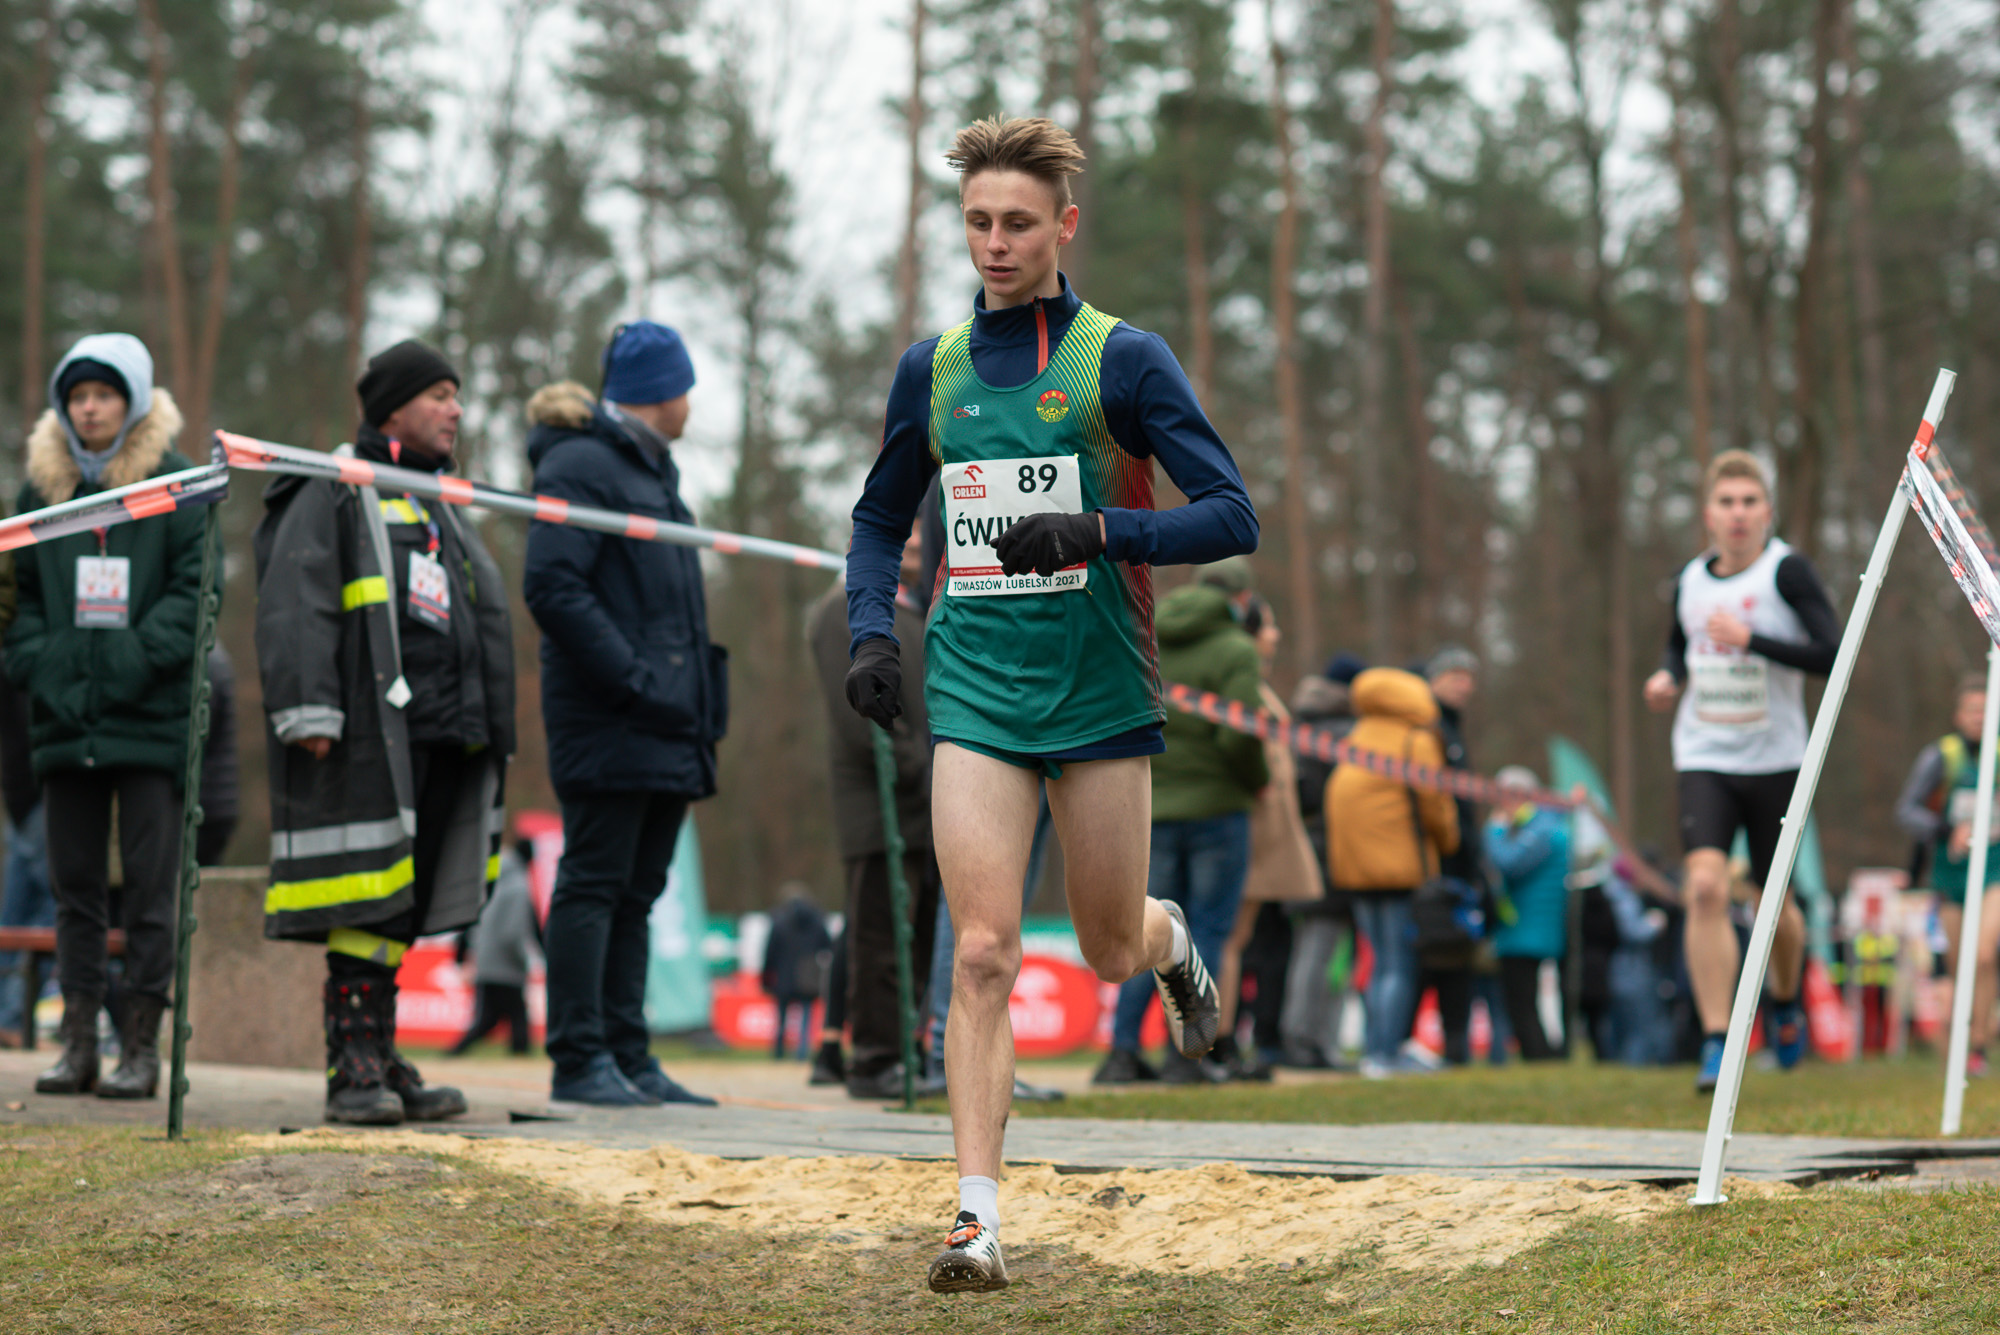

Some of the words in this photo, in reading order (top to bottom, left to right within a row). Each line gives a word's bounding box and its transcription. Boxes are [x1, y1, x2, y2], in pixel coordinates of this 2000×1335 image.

[1018, 464, 1058, 493] 89
[954, 486, 985, 498] ORLEN
[953, 577, 1003, 591] TOMASZÓW
[1006, 578, 1052, 588] LUBELSKI
[1055, 574, 1080, 586] 2021
